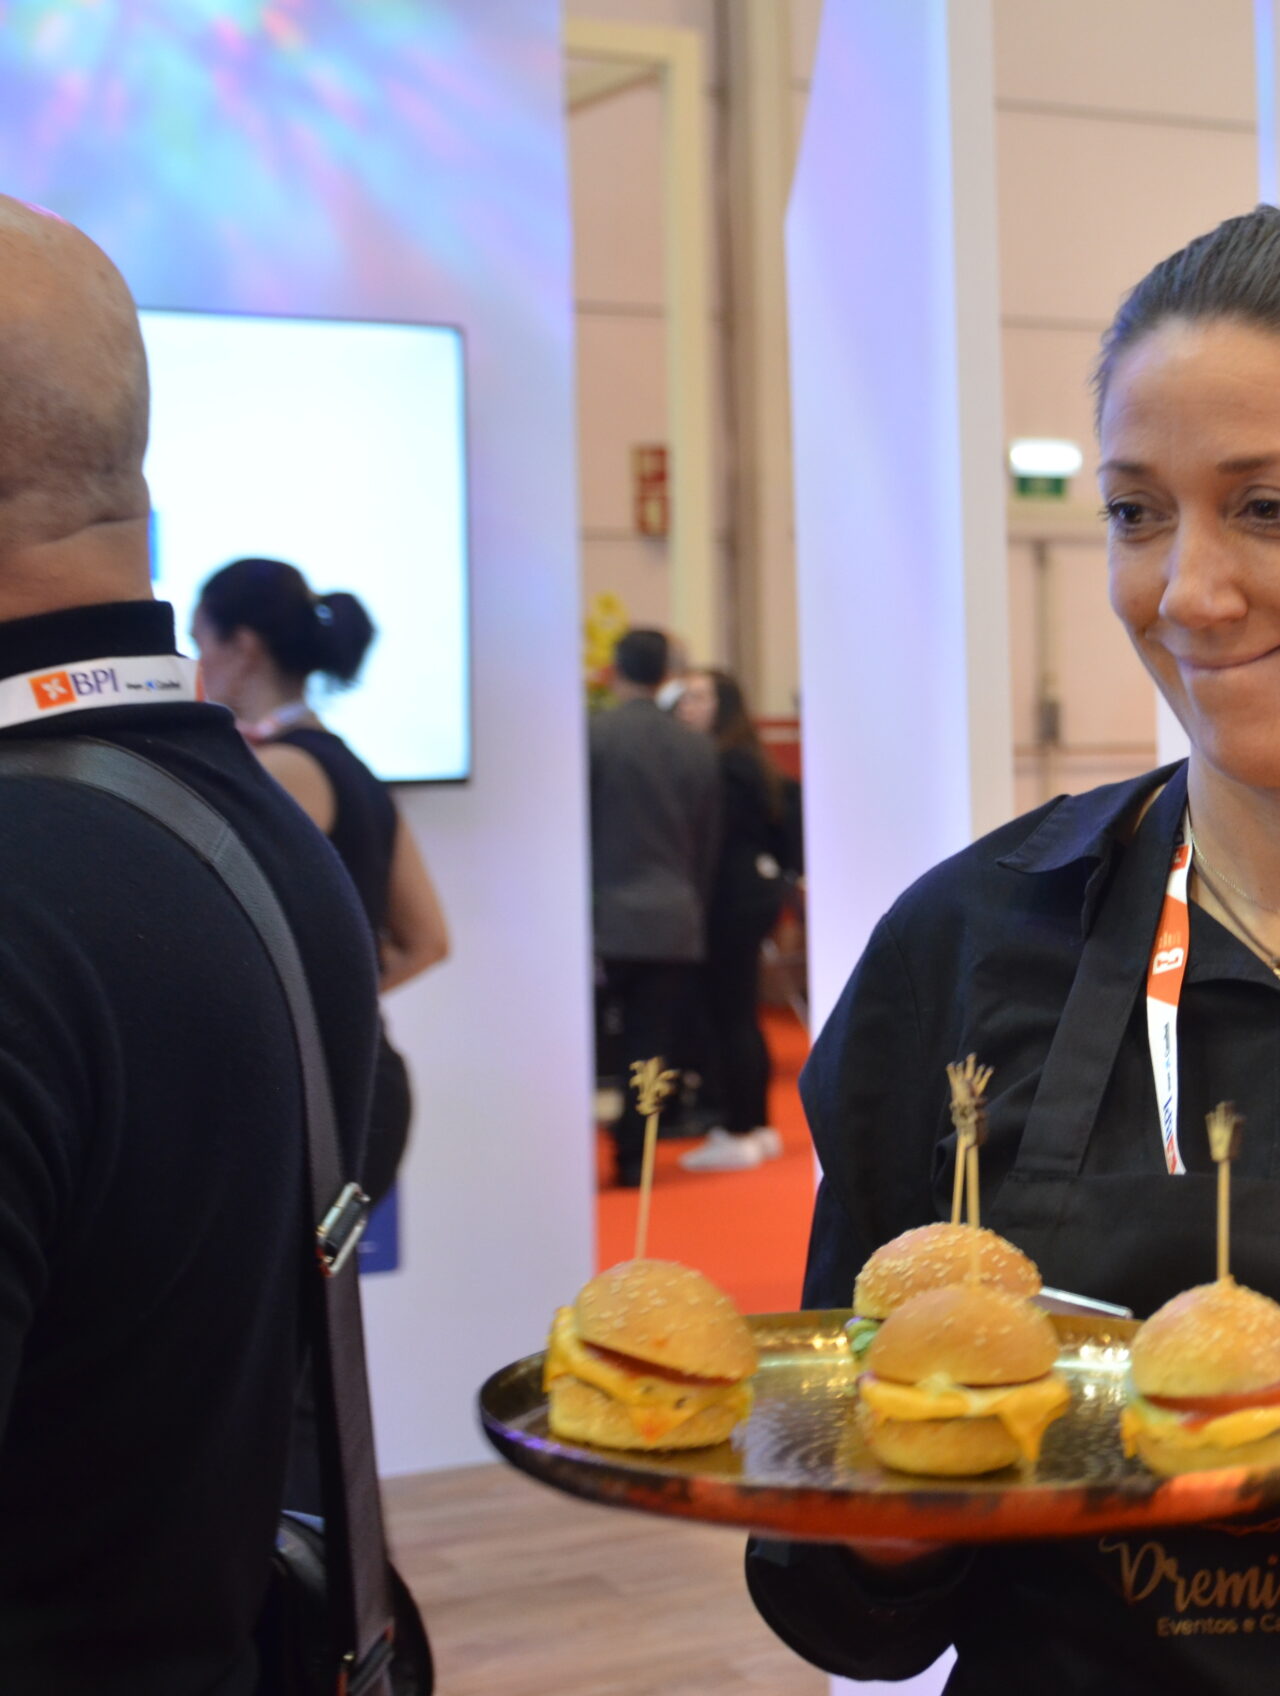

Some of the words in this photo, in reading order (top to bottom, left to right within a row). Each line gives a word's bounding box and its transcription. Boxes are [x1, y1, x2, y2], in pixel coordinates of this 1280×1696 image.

[70, 668, 119, 697] BPI
[1157, 1616, 1239, 1637] Eventos
[1242, 1617, 1256, 1633] e
